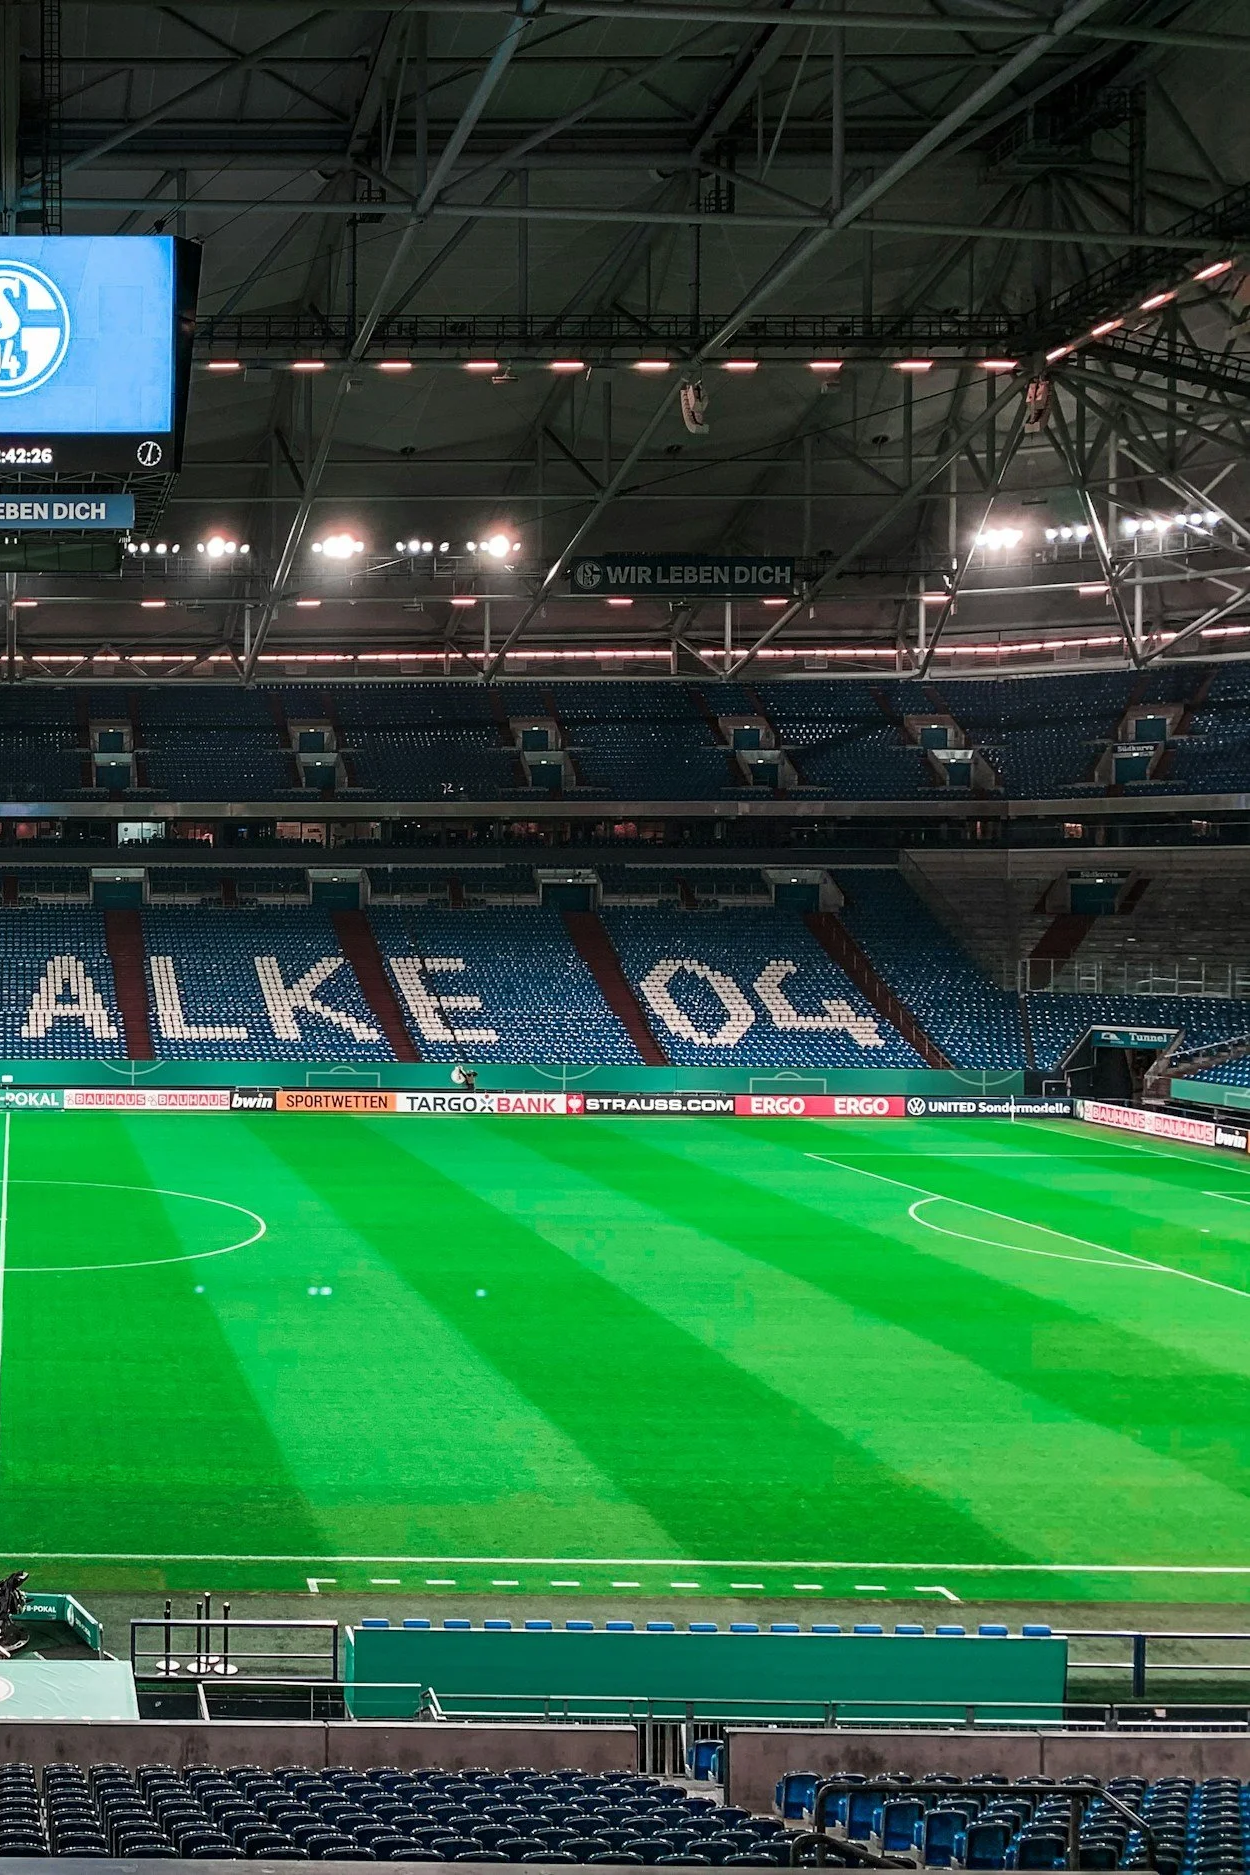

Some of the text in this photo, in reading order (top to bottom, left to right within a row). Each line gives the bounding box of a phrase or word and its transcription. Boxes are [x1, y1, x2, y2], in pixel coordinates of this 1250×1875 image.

[53, 502, 106, 520] DICH
[606, 566, 791, 584] WIR LEBEN DICH
[639, 958, 888, 1050] 04
[1129, 1032, 1167, 1043] Tunnel
[75, 1092, 230, 1106] BAUHAUS BAUHAUS
[231, 1093, 388, 1109] bwin SPORTWETTEN
[585, 1098, 734, 1112] STRAUSS.COM
[751, 1097, 889, 1115] ERGO ERGO
[928, 1101, 976, 1113] UNITED
[978, 1101, 1071, 1114] Sondermodelle
[1092, 1105, 1213, 1142] BAUHAUS BAUHAUS
[1215, 1127, 1247, 1149] bwin
